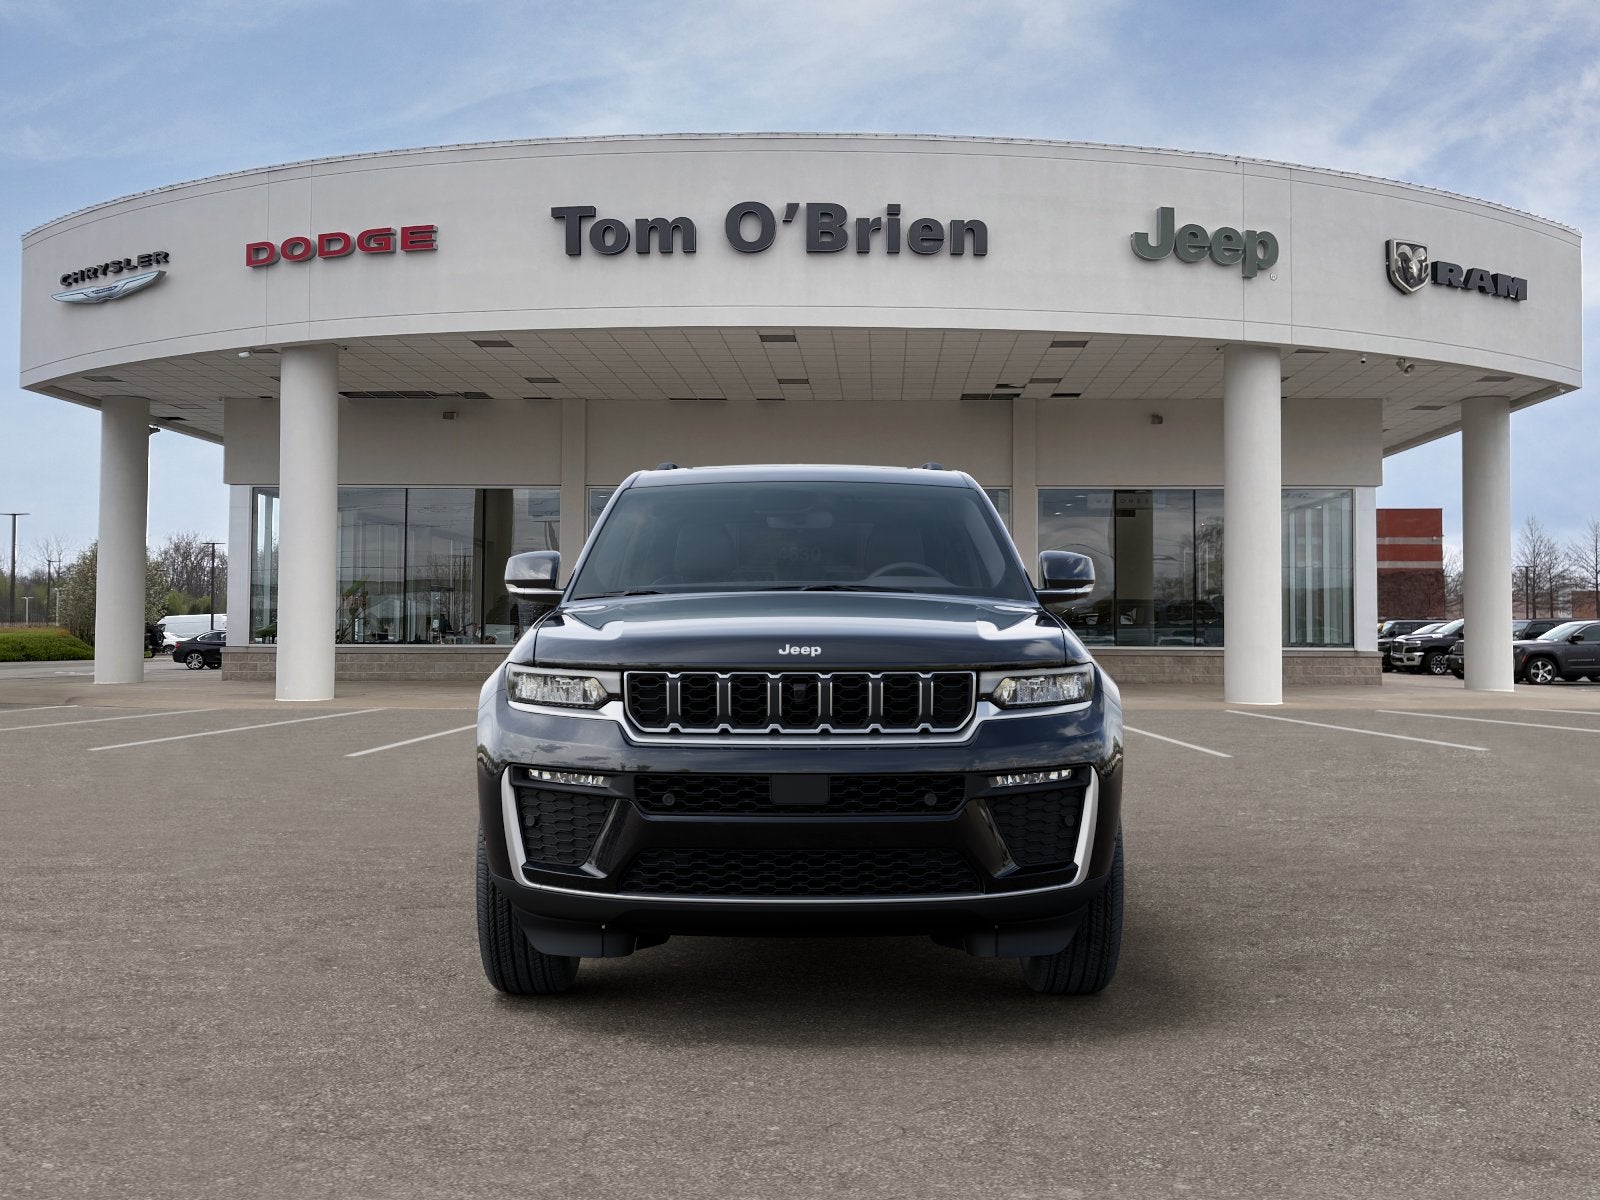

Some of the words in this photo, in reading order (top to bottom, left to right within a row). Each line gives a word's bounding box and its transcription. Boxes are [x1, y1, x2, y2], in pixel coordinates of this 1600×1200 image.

[245, 224, 439, 268] DODGE
[551, 205, 697, 256] Tom
[724, 201, 989, 256] O'Brien
[1130, 206, 1280, 279] Jeep
[60, 250, 170, 287] CHRYSLER
[1430, 260, 1528, 302] RAM
[778, 643, 822, 657] Jeep
